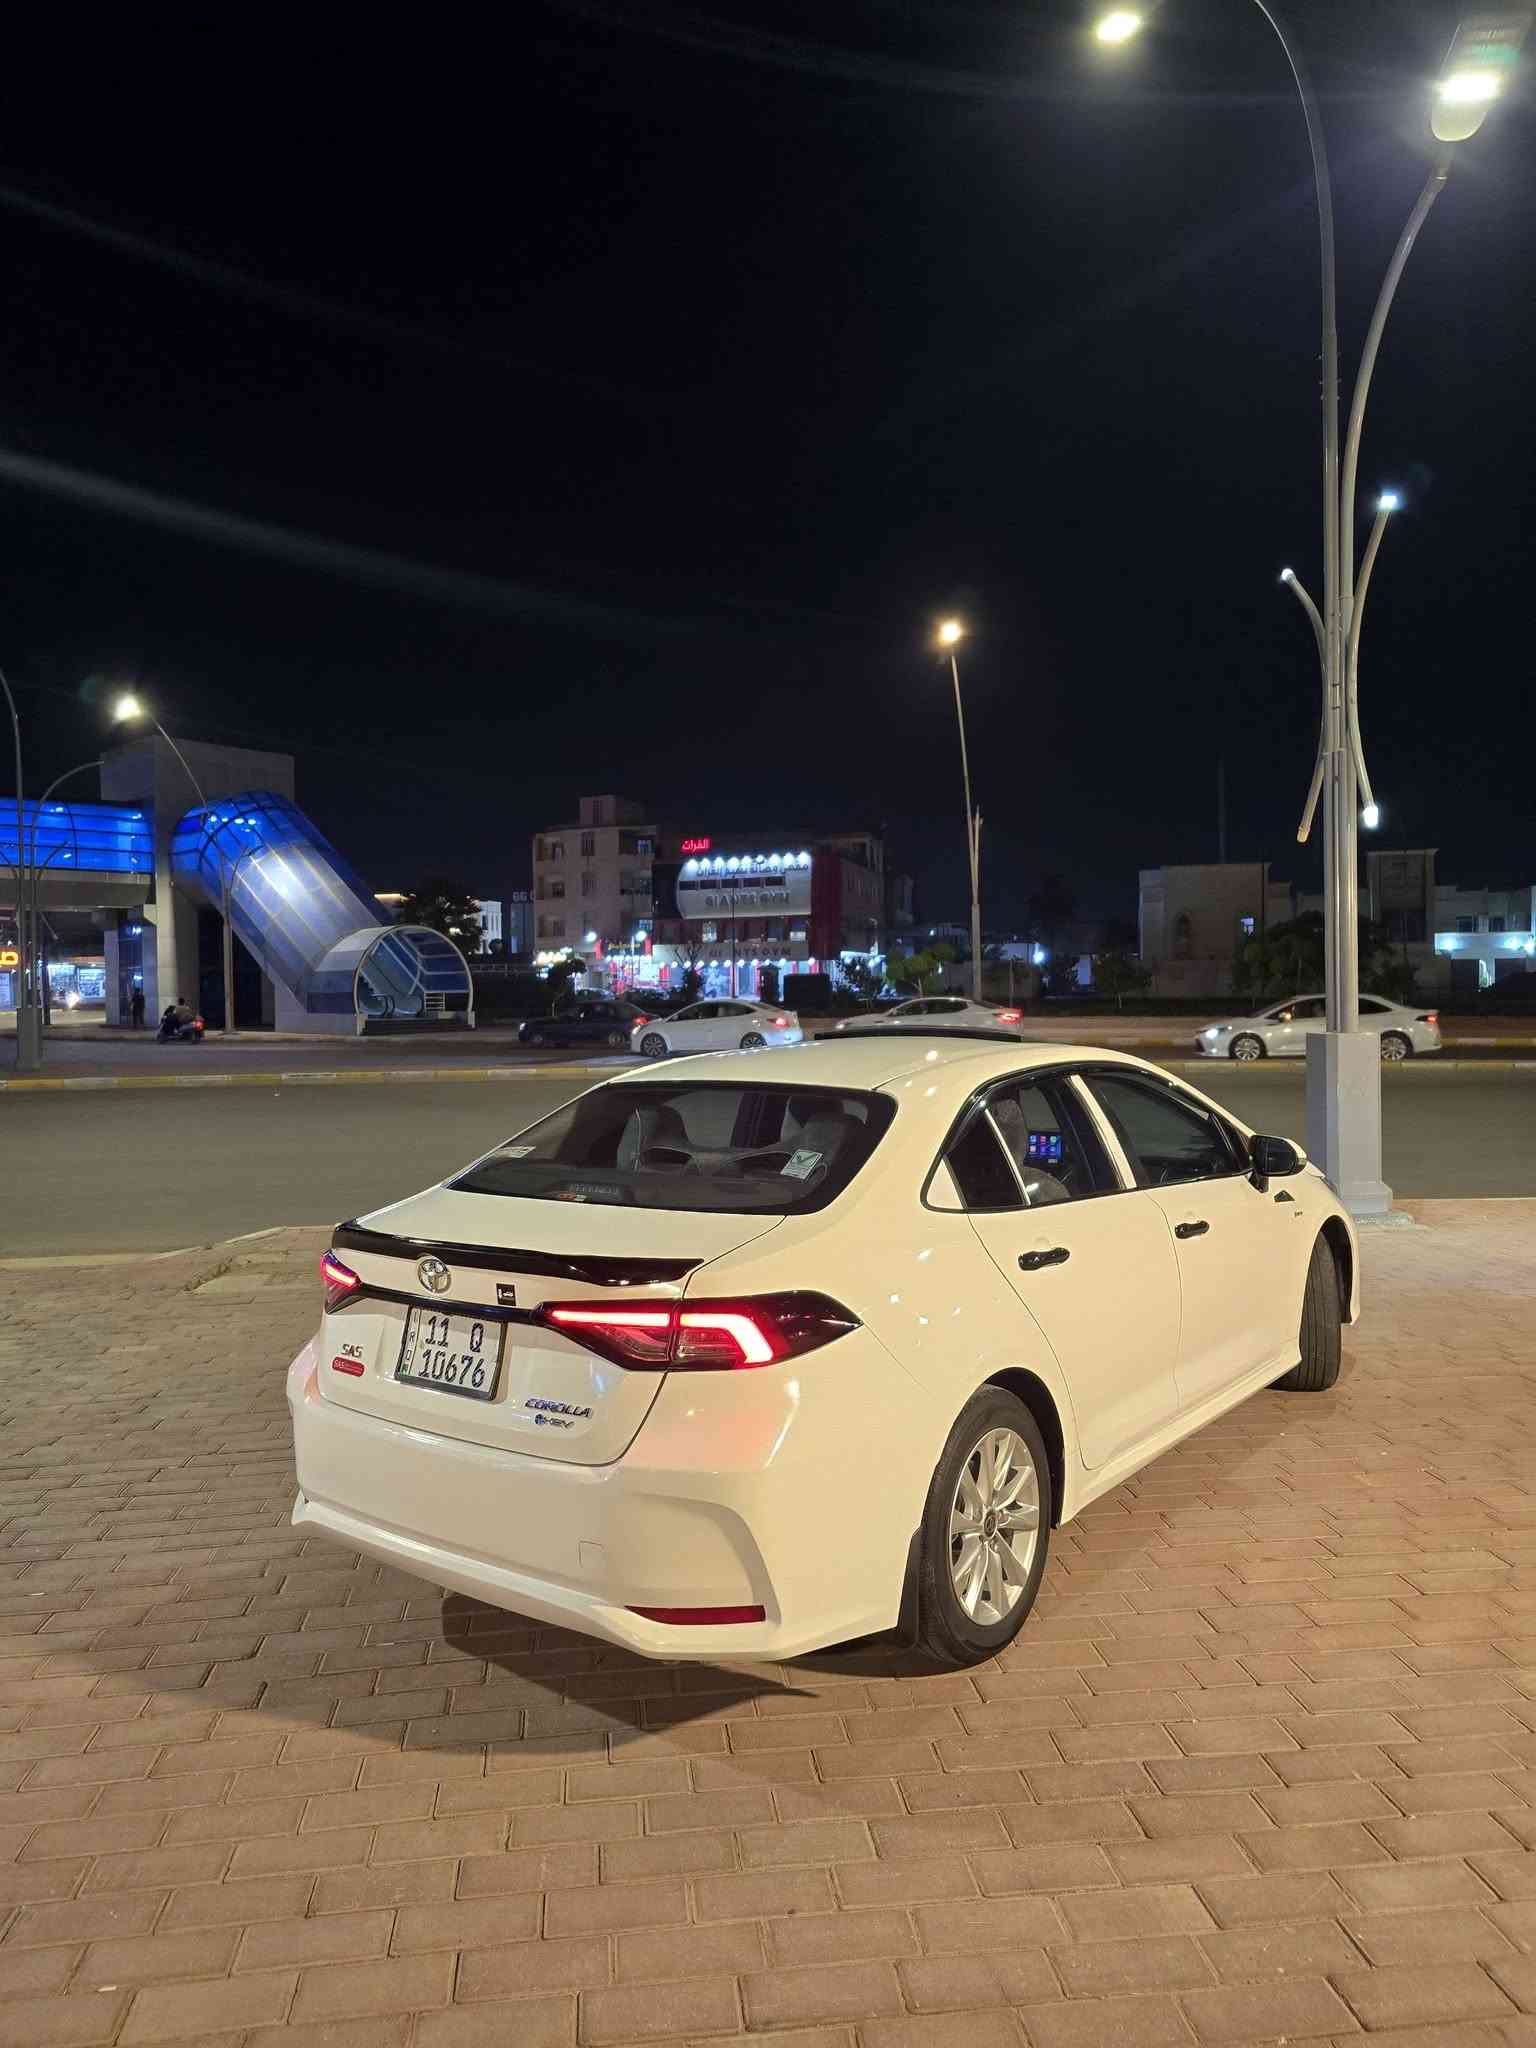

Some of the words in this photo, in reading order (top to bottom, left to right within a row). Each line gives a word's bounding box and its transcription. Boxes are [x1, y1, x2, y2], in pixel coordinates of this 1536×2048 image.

[682, 838, 709, 852] الفرات
[425, 1315, 449, 1347] 11
[470, 1322, 484, 1353] Q
[341, 1343, 364, 1358] SAS
[418, 1348, 486, 1388] 10676
[524, 1398, 592, 1417] COROLLA
